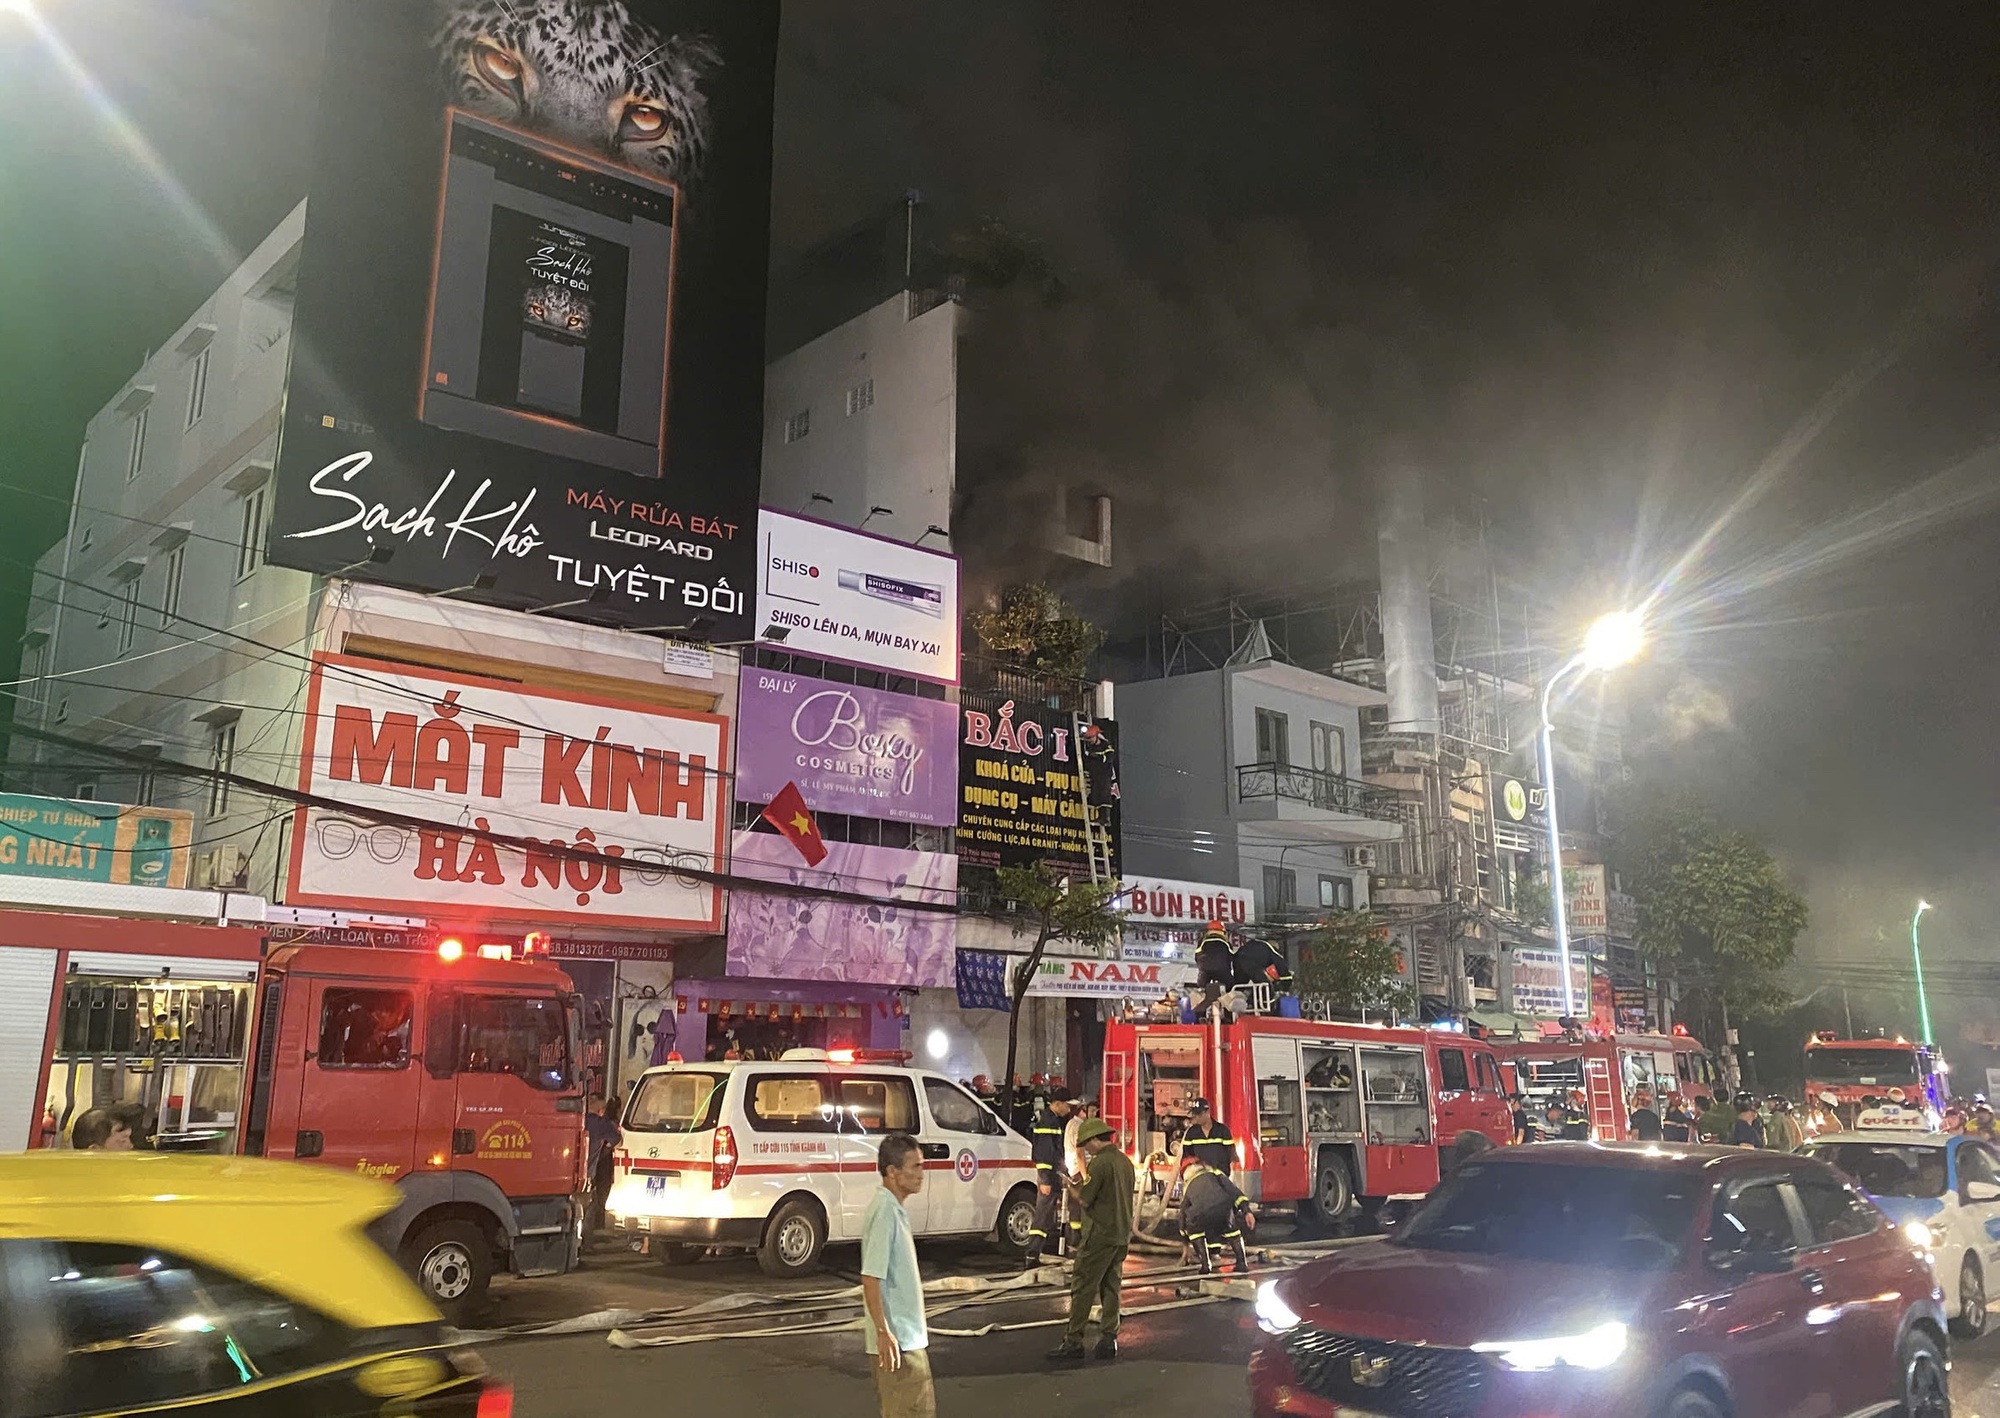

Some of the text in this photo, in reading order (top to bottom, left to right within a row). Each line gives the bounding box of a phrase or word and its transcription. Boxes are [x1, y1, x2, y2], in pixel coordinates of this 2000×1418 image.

[531, 267, 568, 284] TUYỆT
[283, 451, 545, 560] Sạch Khô
[567, 488, 739, 540] MÁY RỬA BÁT
[590, 520, 713, 561] LEOPARD
[772, 557, 820, 578] SHISO
[548, 554, 744, 615] TUYỆT ĐỐI
[868, 579, 904, 593] SHISOFIX
[771, 610, 941, 656] SHISO LÊN DA, MỤN BAY XA!
[759, 676, 797, 694] ĐẠI LÝ
[965, 700, 1044, 756] BẮC
[329, 690, 707, 821] MẮT KÍNH
[796, 754, 894, 780] COSMETICS
[976, 759, 1009, 781] KHOÁ
[1011, 760, 1036, 785] CỬA
[1045, 771, 1069, 795] PHỤ
[964, 785, 999, 808] DỤNG
[1000, 791, 1018, 814] CỤ
[955, 826, 973, 839] KÍNH
[976, 828, 1001, 843] CƯỜNG
[963, 814, 992, 827] CHUYÊN
[994, 818, 1013, 829] CUNG
[1015, 819, 1030, 831] CẤP
[1031, 822, 1045, 833] CÁC
[1046, 827, 1062, 837] LOẠI
[1063, 827, 1077, 840] PHỤ
[27, 831, 103, 870] NHẤT
[413, 817, 625, 906] HÀ NỘI
[1131, 885, 1246, 924] BÚN RIÊU
[1069, 962, 1162, 984] NAM
[503, 1134, 525, 1149] 114
[355, 1158, 400, 1178] Ziegler
